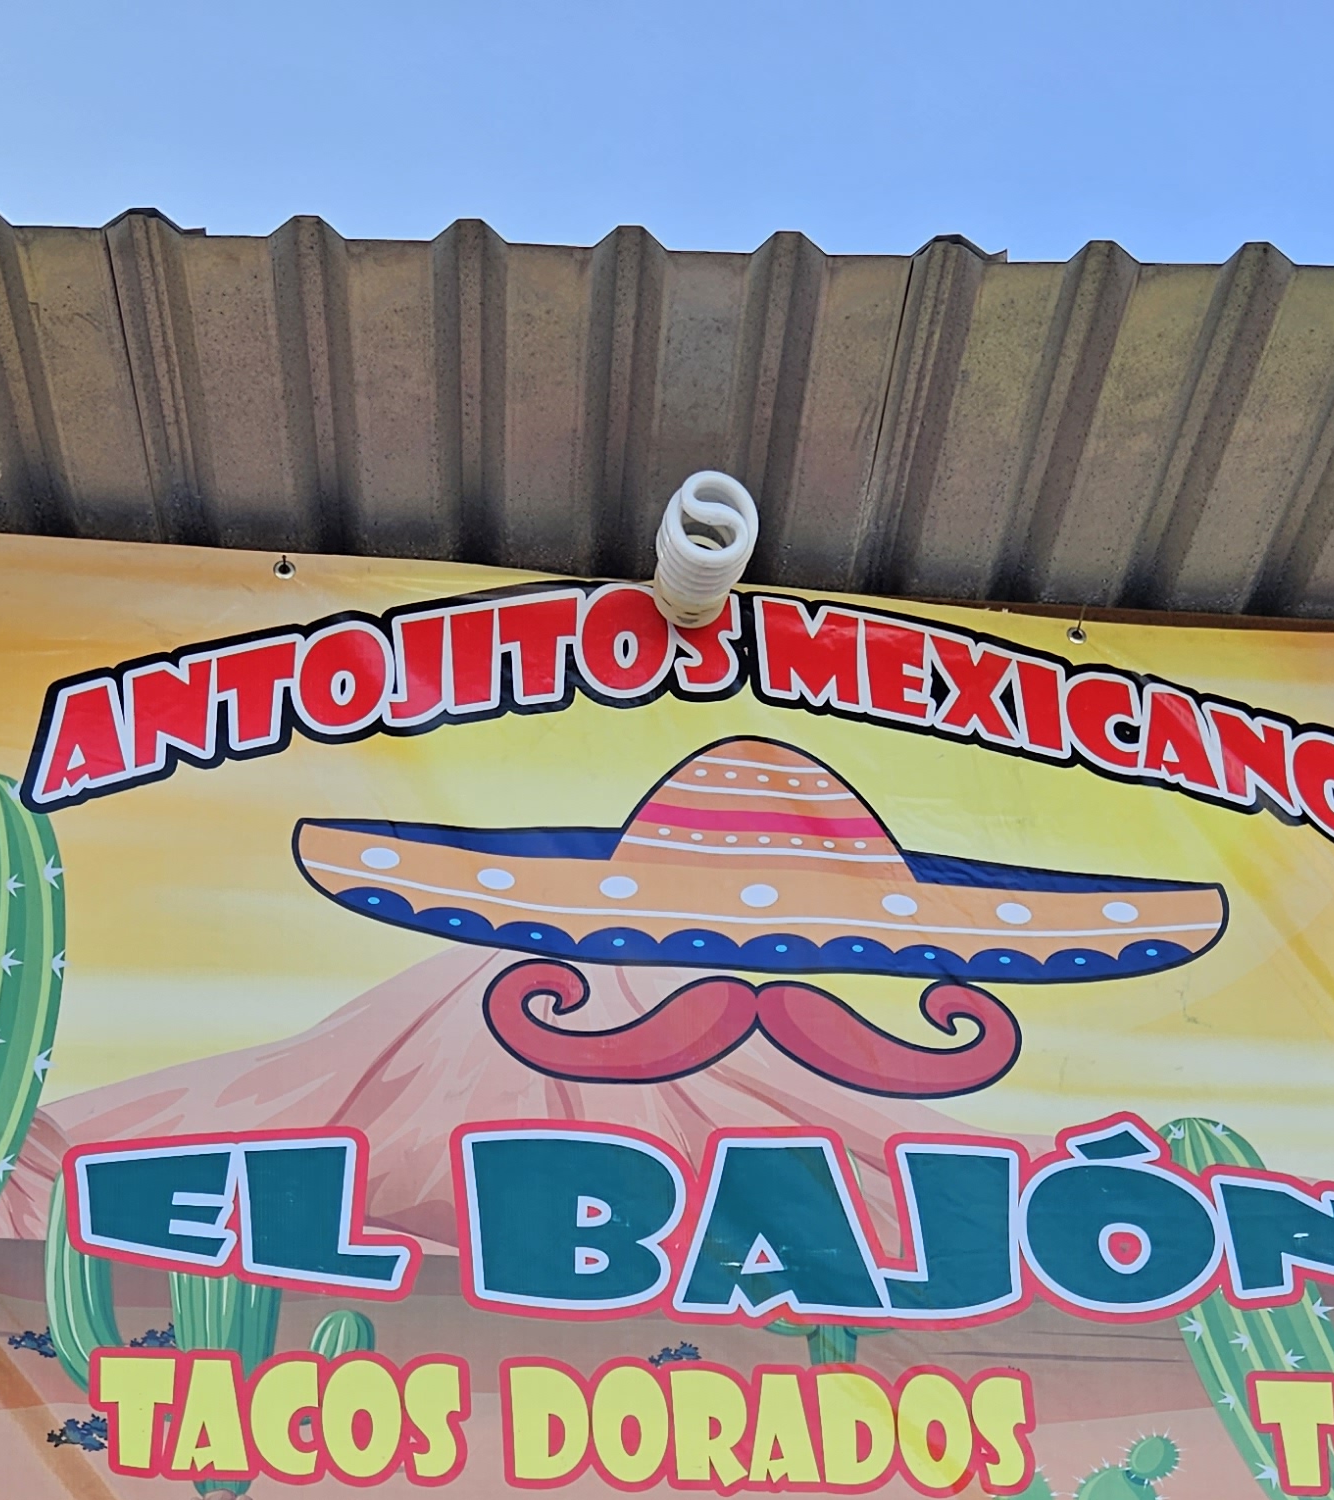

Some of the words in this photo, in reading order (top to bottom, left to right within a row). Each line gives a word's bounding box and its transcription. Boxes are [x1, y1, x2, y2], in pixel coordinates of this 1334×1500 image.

[73, 1136, 412, 1292] EL
[98, 1354, 461, 1484] TACOS
[506, 1361, 1029, 1494] DORADOS
